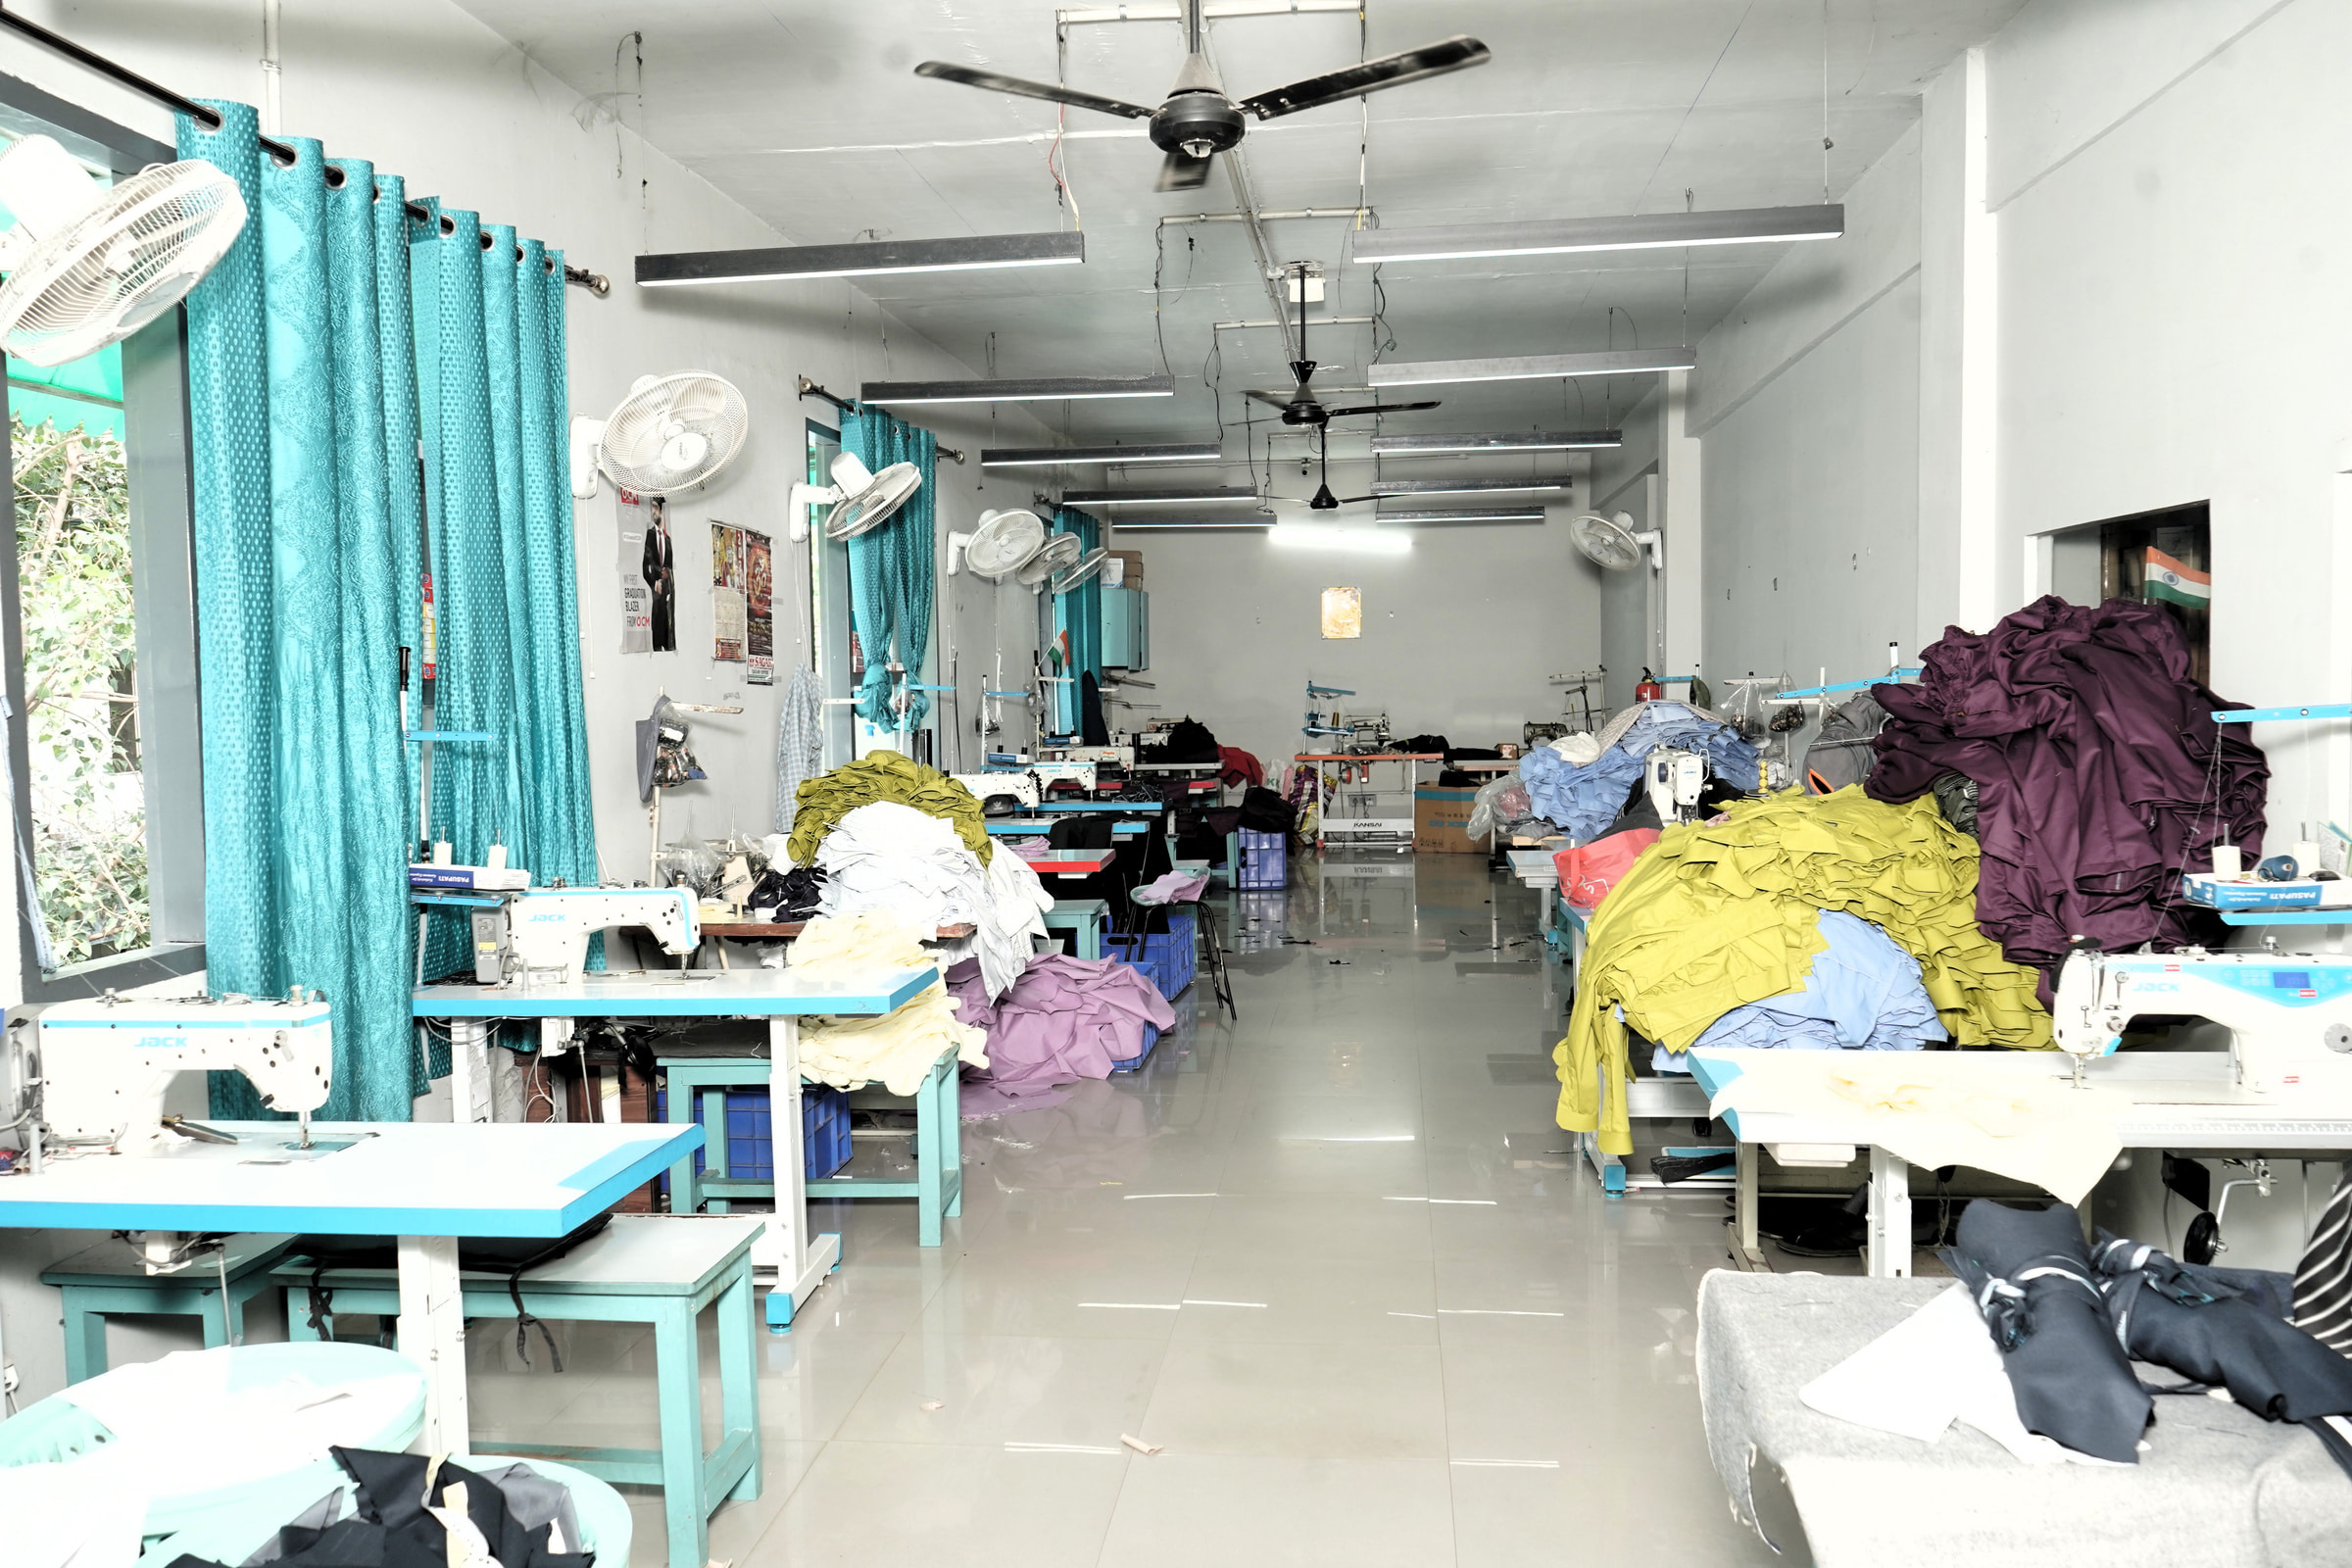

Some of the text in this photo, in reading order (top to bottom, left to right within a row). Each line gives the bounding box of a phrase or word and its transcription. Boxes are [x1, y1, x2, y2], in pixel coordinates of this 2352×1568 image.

[624, 588, 647, 599] GRADUATION
[625, 601, 640, 612] BLAZER
[636, 615, 651, 627] OCM
[2269, 891, 2317, 900] PASUPATI
